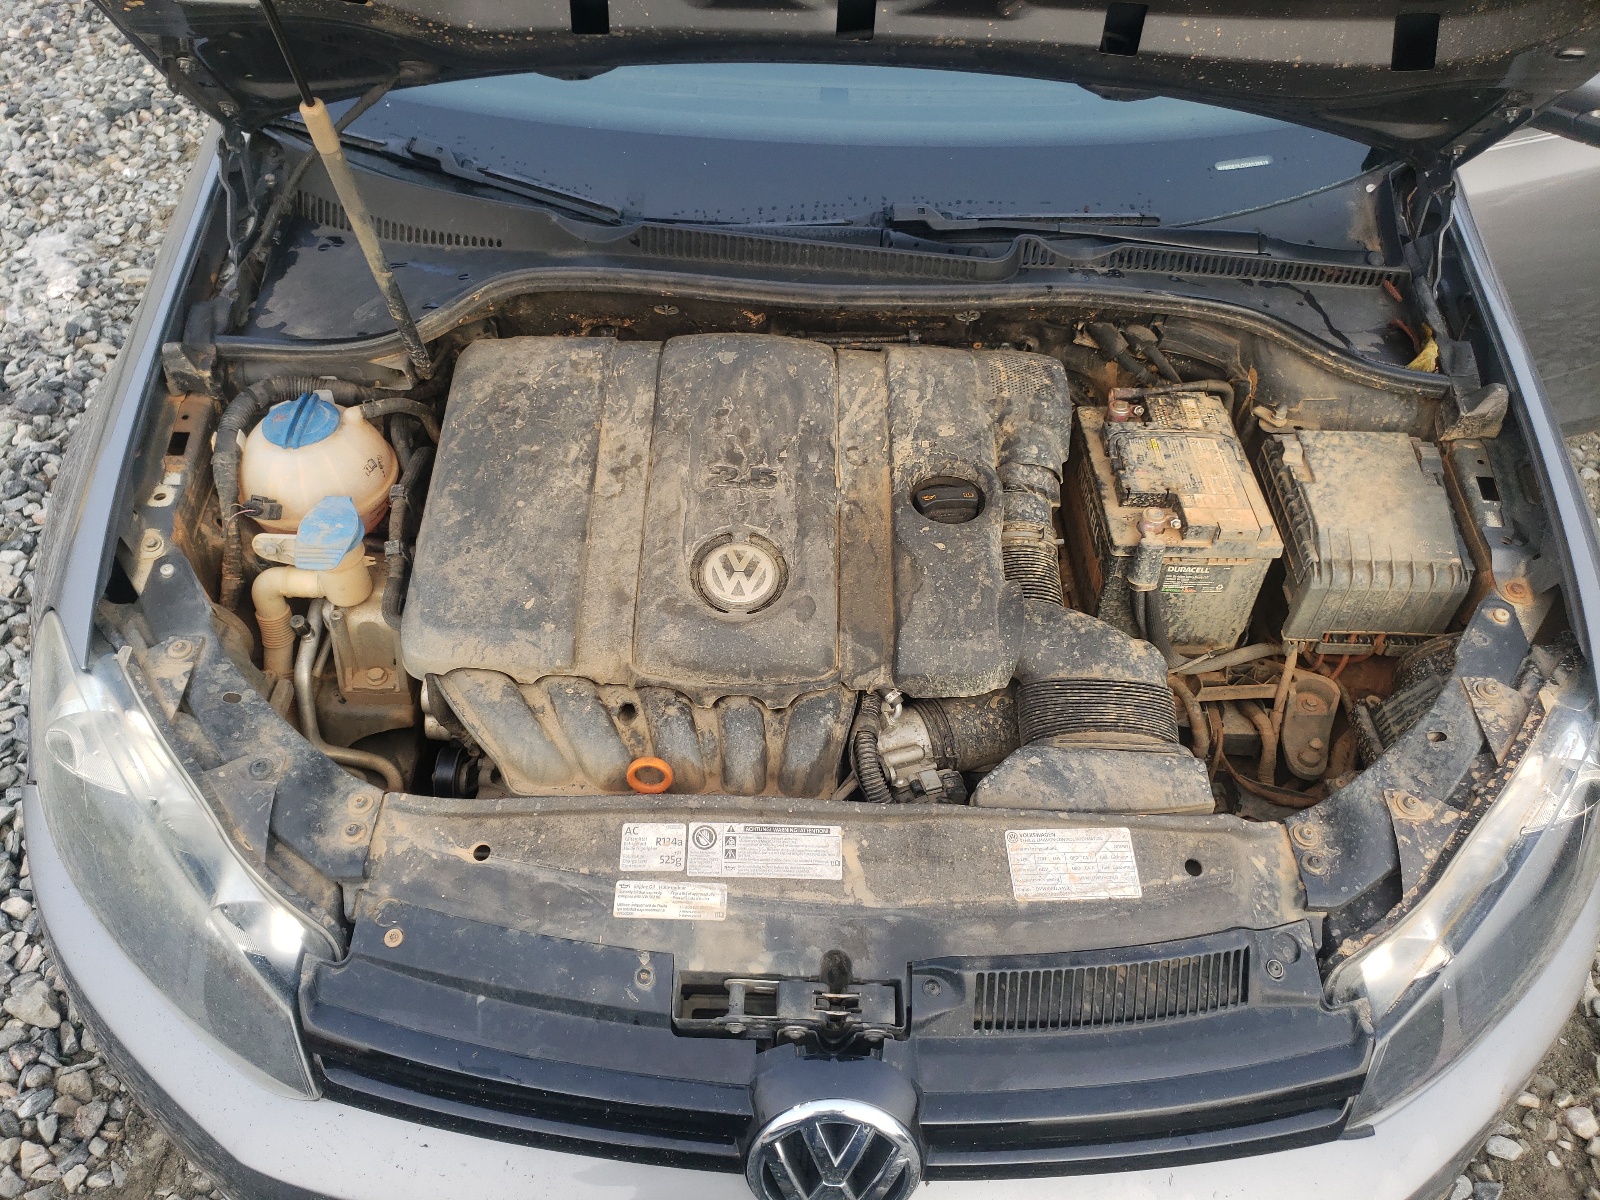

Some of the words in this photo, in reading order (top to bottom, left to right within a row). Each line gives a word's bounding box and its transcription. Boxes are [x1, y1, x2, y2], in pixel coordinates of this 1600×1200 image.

[1167, 566, 1210, 574] DURACELL
[624, 826, 640, 836] AC
[655, 837, 683, 847] R134a
[659, 855, 682, 867] 525g
